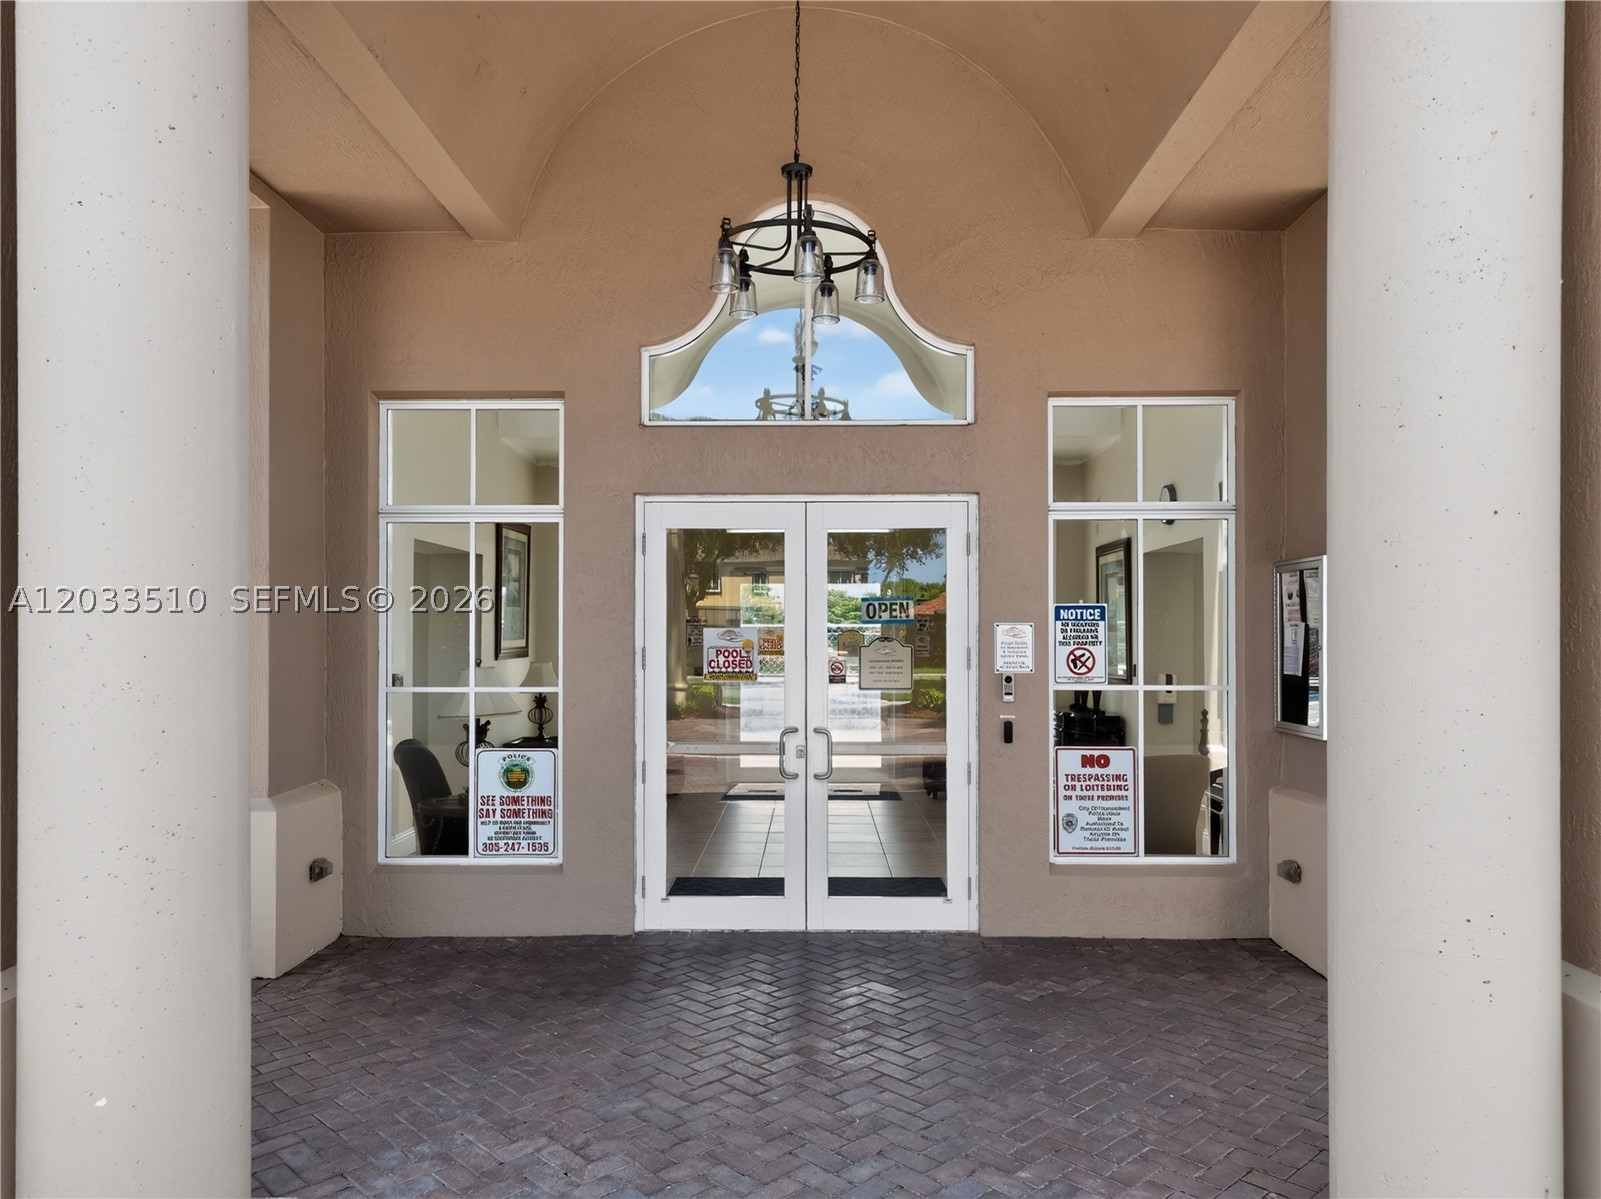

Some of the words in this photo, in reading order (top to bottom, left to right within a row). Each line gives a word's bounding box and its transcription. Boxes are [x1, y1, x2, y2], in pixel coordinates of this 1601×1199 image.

[866, 602, 910, 620] OPEN
[1060, 609, 1101, 620] NOTICE
[716, 649, 745, 659] POOL
[709, 660, 752, 670] CLOSED
[1081, 754, 1110, 768] NO
[1065, 774, 1128, 782] TRESPASSING
[480, 795, 496, 807] SEE
[499, 795, 552, 807] SOMETHING
[479, 808, 497, 820] SAY
[500, 808, 553, 820] SOMETHING
